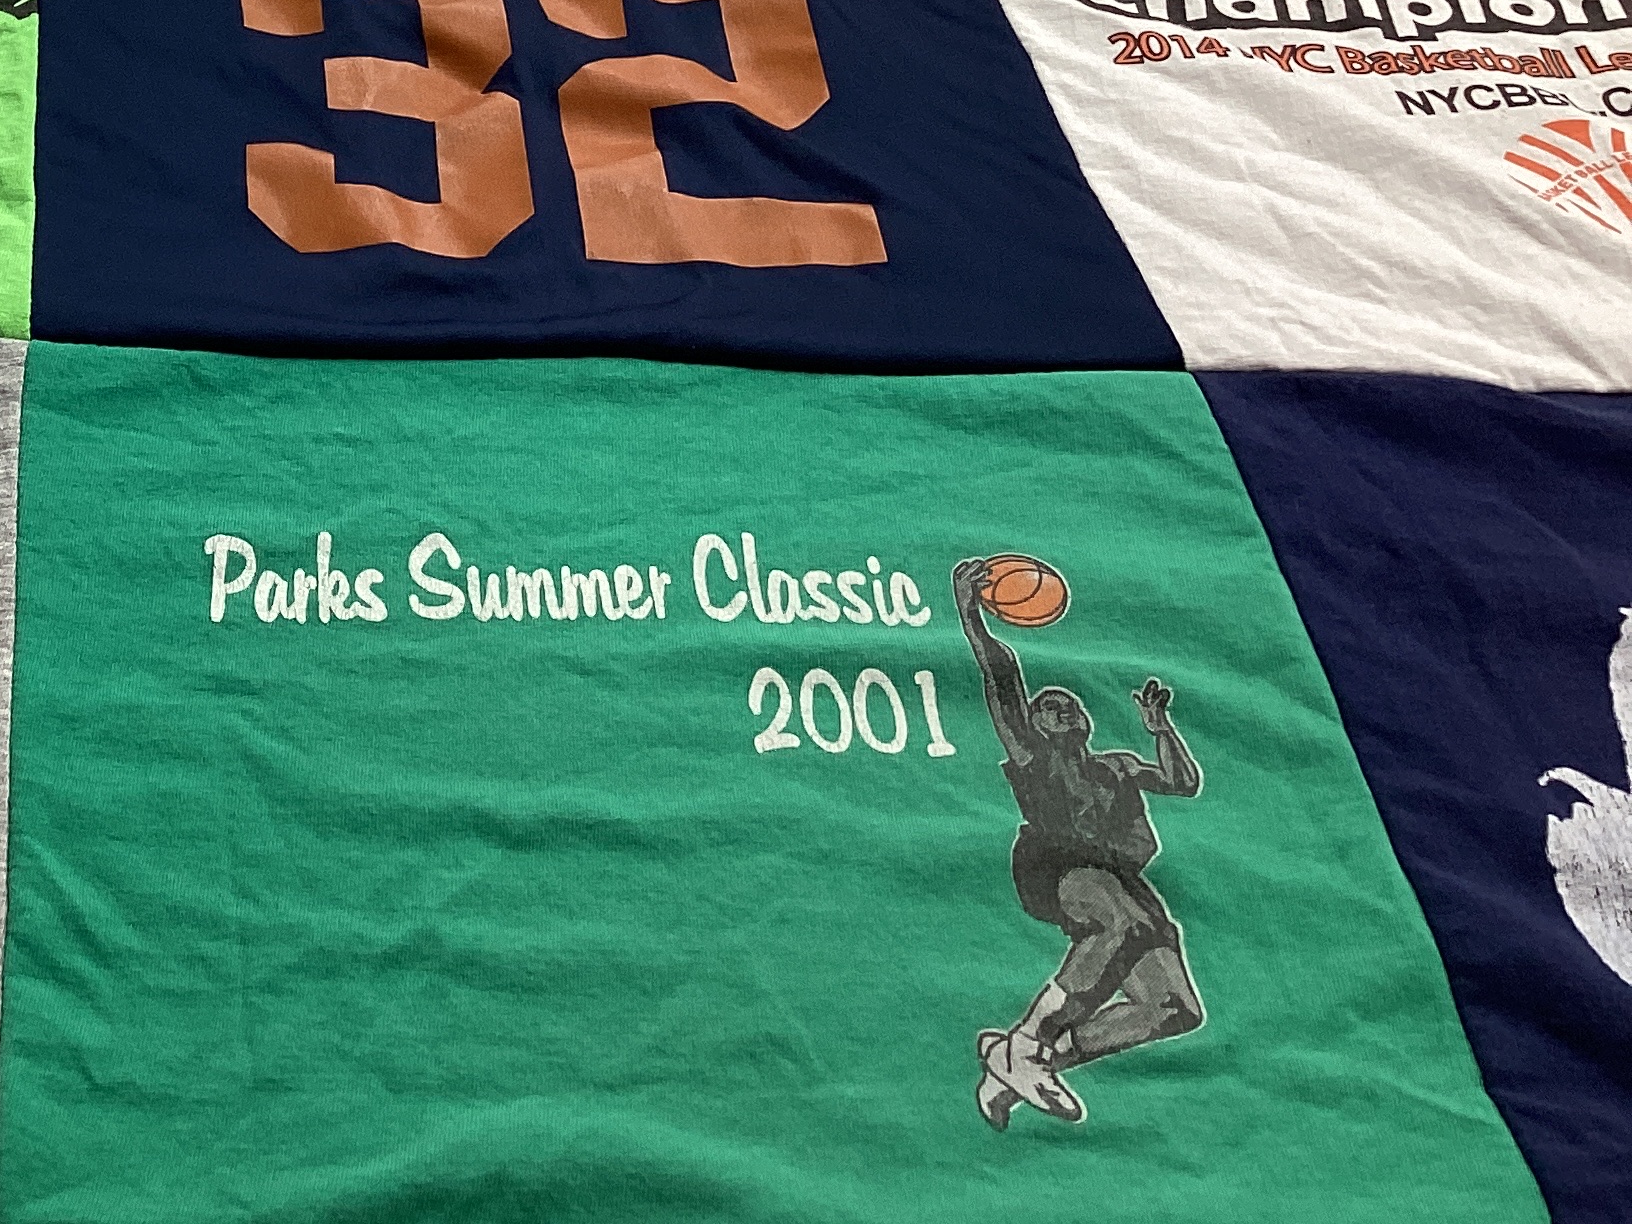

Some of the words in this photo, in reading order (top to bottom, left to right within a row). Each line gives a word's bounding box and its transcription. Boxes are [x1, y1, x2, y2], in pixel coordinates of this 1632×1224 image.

[1108, 31, 1229, 67] 2014
[1340, 42, 1576, 79] Basketball
[205, 533, 389, 625] Parks
[408, 533, 670, 623] Summer
[692, 533, 931, 627] Classic
[749, 667, 955, 758] 2001
